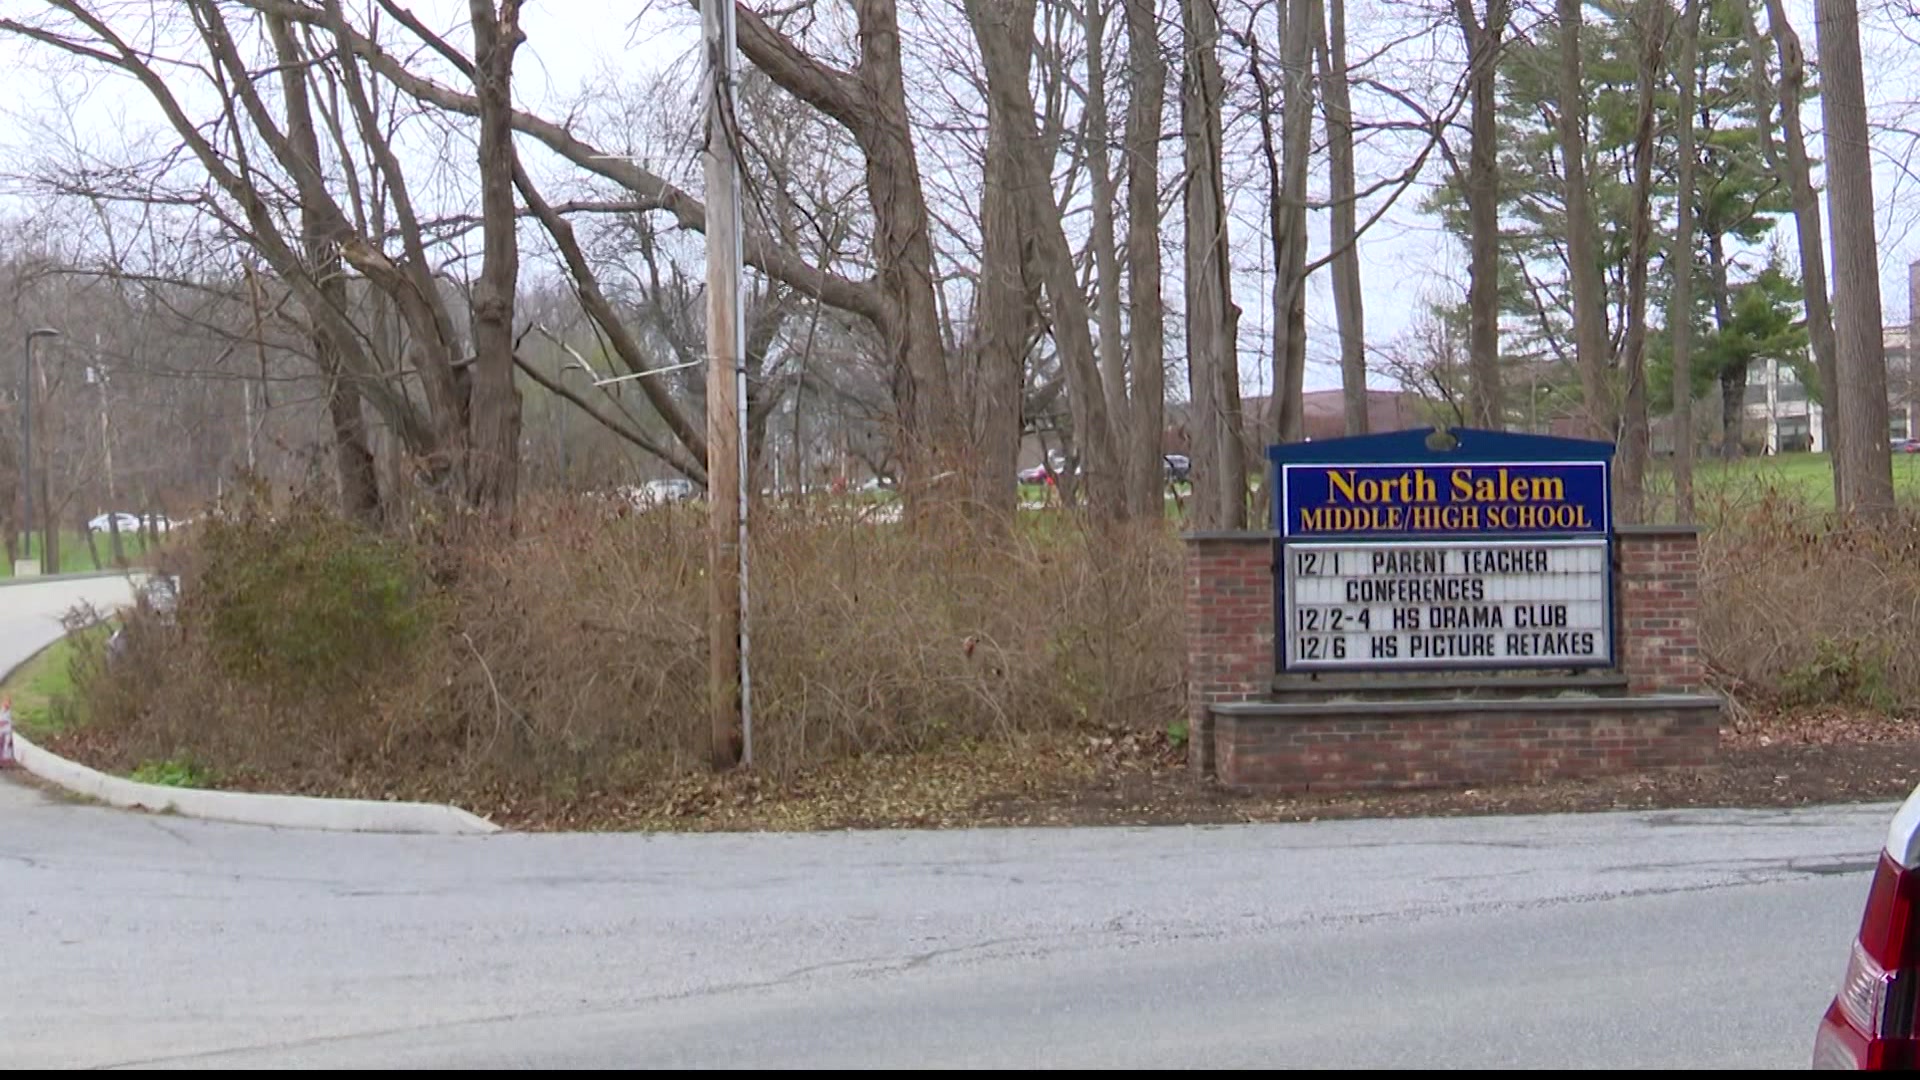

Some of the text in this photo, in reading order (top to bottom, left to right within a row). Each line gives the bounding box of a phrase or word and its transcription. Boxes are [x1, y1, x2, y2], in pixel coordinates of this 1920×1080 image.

[1327, 467, 1565, 503] North Salem
[1300, 504, 1592, 531] MIDDLE/HIGH SCHOOL
[1372, 551, 1448, 574] PARENT
[1462, 550, 1548, 573] TEACHER
[1346, 579, 1484, 602] CONFERENCES
[1299, 605, 1568, 631] 12/2-4 HS DRAMA CLUB
[1300, 632, 1594, 659] 12/6 HS PICTURE RETAKES
